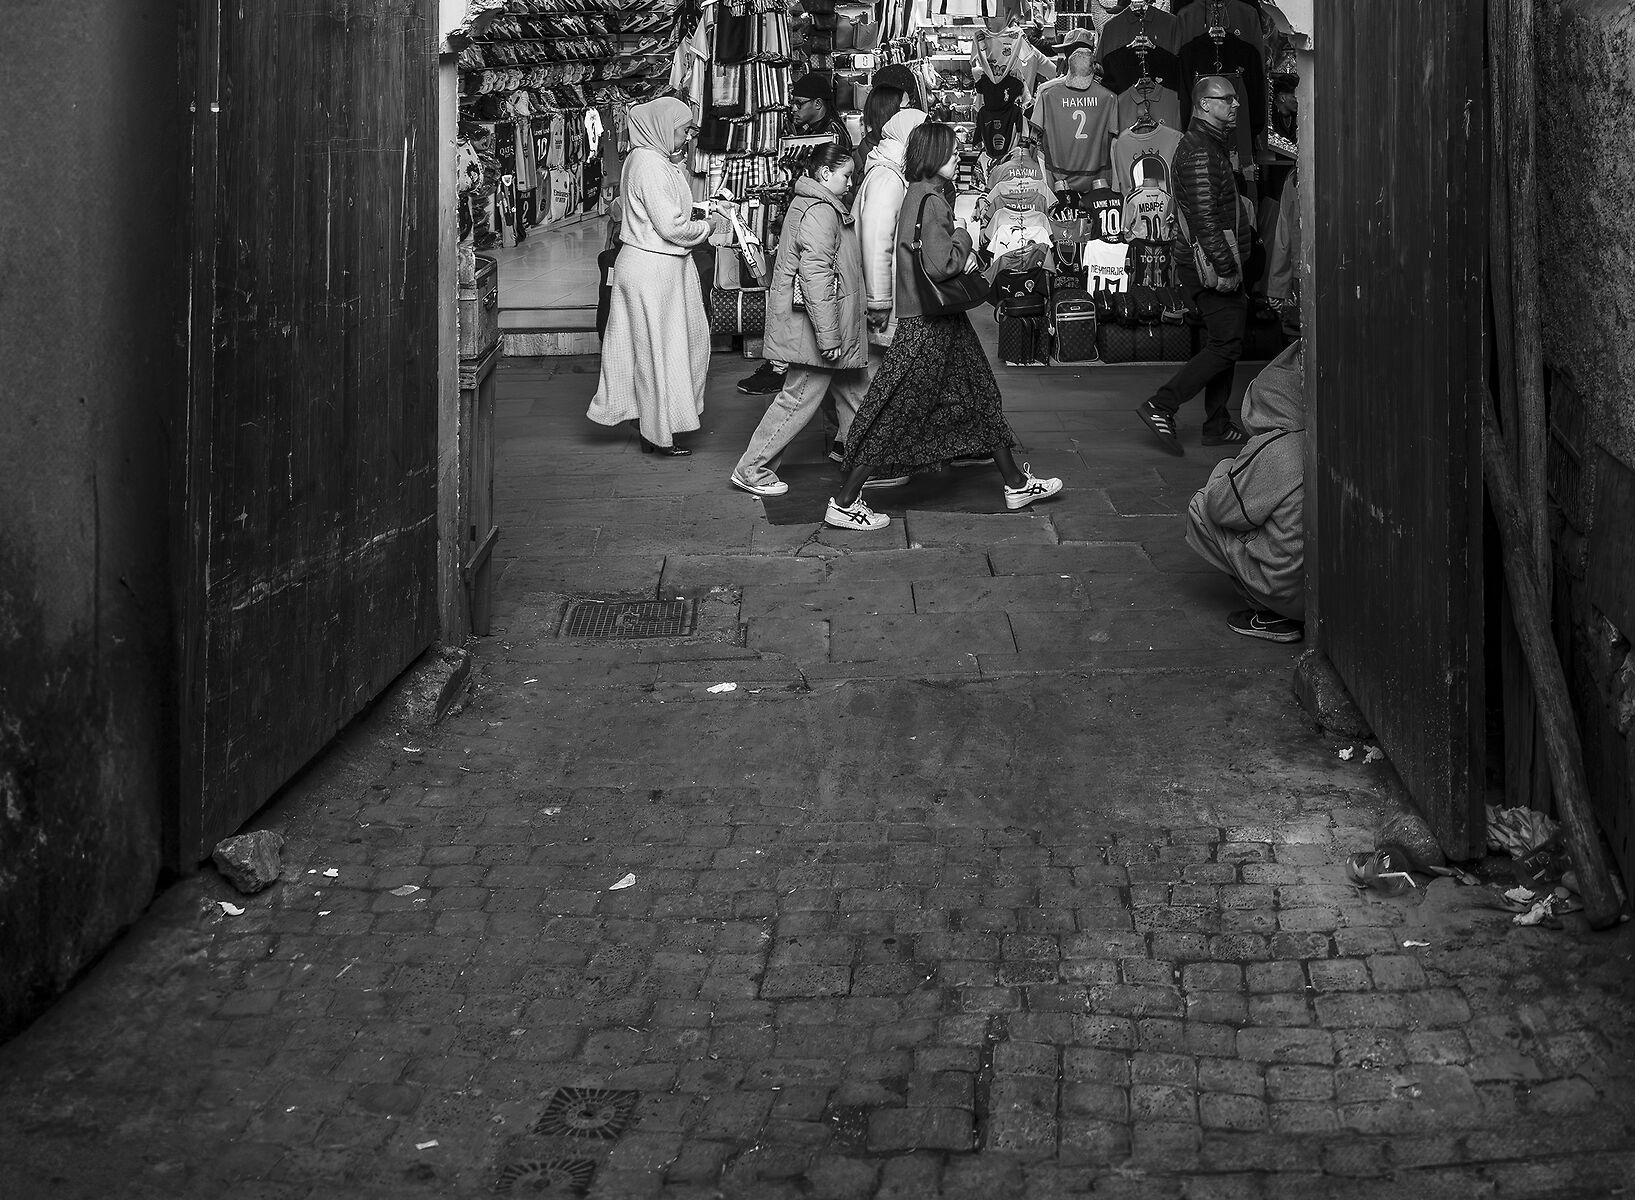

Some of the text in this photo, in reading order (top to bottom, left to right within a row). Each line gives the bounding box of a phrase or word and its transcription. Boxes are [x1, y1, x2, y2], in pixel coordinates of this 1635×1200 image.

[1062, 96, 1098, 108] HAKIMI
[1072, 109, 1089, 140] 2
[1009, 168, 1037, 177] HAKIMI
[1098, 208, 1121, 236] 10
[1140, 255, 1166, 263] TOTO
